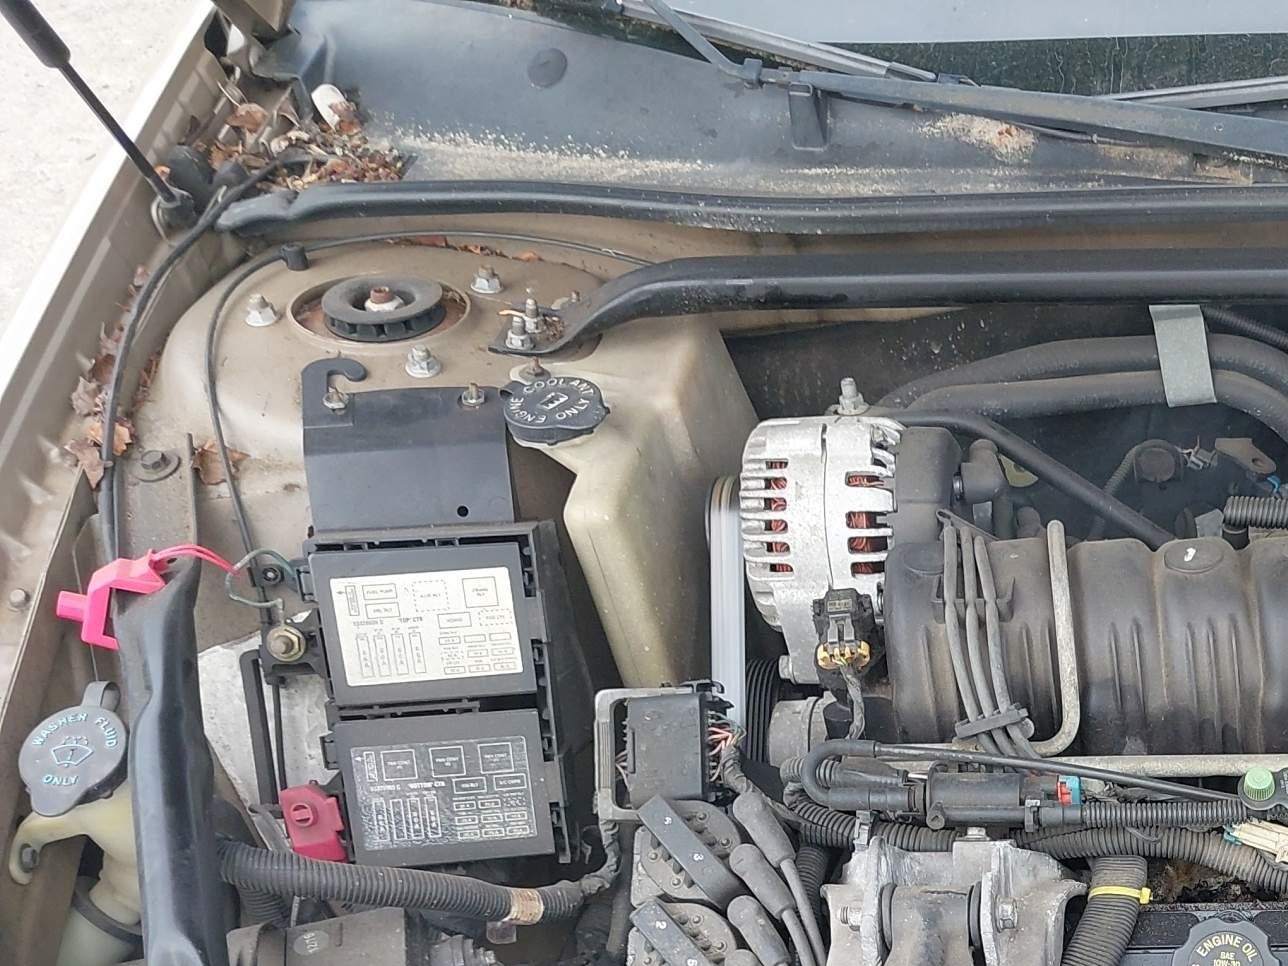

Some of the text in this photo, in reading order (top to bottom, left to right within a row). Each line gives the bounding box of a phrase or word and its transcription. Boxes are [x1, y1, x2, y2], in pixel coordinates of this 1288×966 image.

[556, 398, 590, 419] ONLY
[32, 713, 118, 749] WASHER FLUID
[43, 774, 79, 786] ONLY
[656, 920, 667, 929] 2
[1195, 934, 1258, 962] ENGINE OIL
[1220, 951, 1236, 960] SAE
